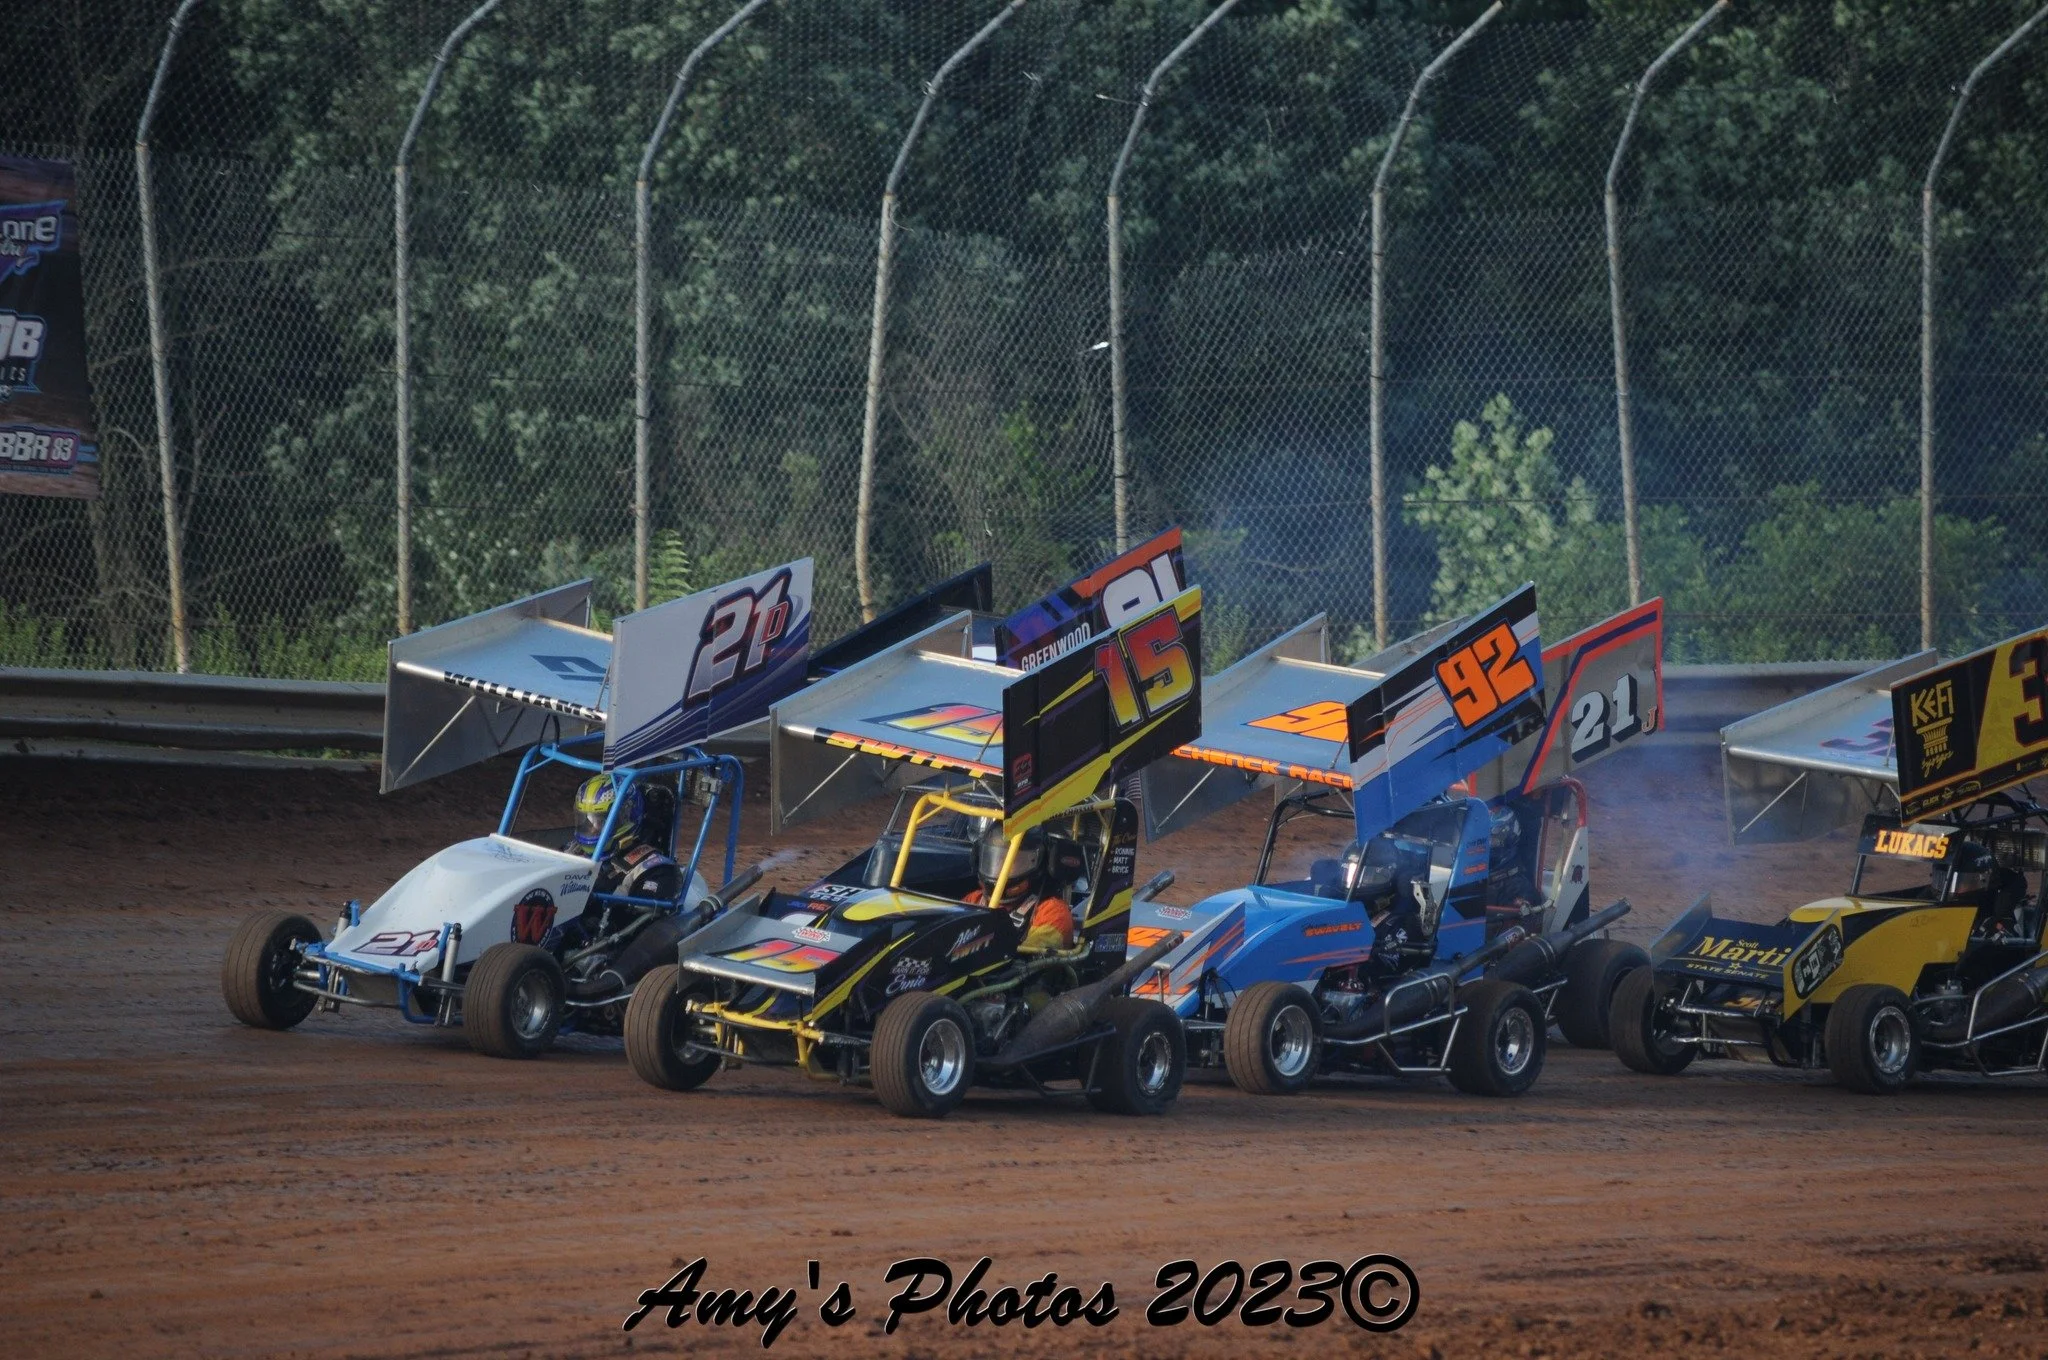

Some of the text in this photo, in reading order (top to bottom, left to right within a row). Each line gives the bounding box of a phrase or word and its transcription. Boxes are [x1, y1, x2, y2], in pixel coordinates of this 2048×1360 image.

[1021, 621, 1092, 673] GREENWOOD
[1094, 602, 1196, 736] 15
[1435, 618, 1538, 729] 92
[1910, 680, 1955, 728] KEFI
[1873, 828, 1950, 860] LUKACS
[1735, 939, 1759, 949] Scott
[1686, 963, 1770, 980] STATE SENATE
